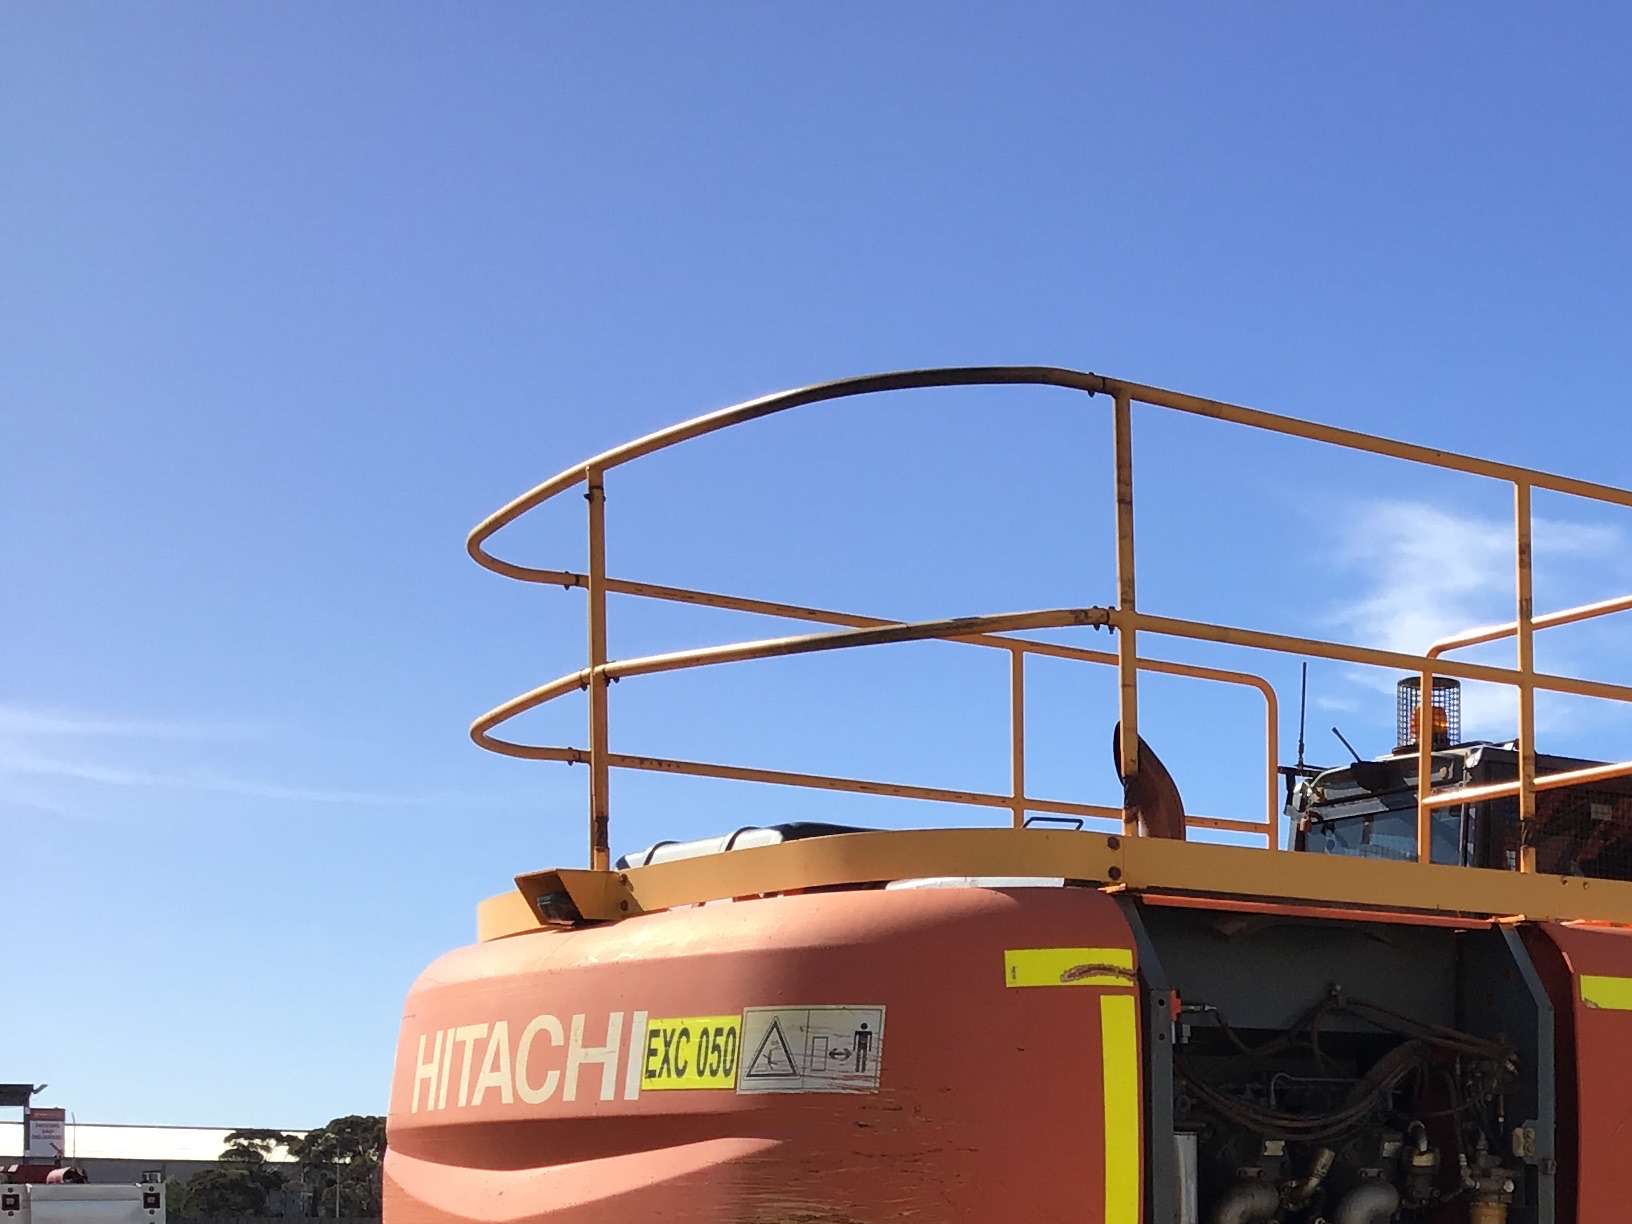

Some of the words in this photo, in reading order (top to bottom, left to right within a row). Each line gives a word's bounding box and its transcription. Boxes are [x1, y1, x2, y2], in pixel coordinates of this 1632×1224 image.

[411, 1011, 648, 1114] HITACHI
[646, 1027, 691, 1079] EXC
[695, 1027, 737, 1079] 050
